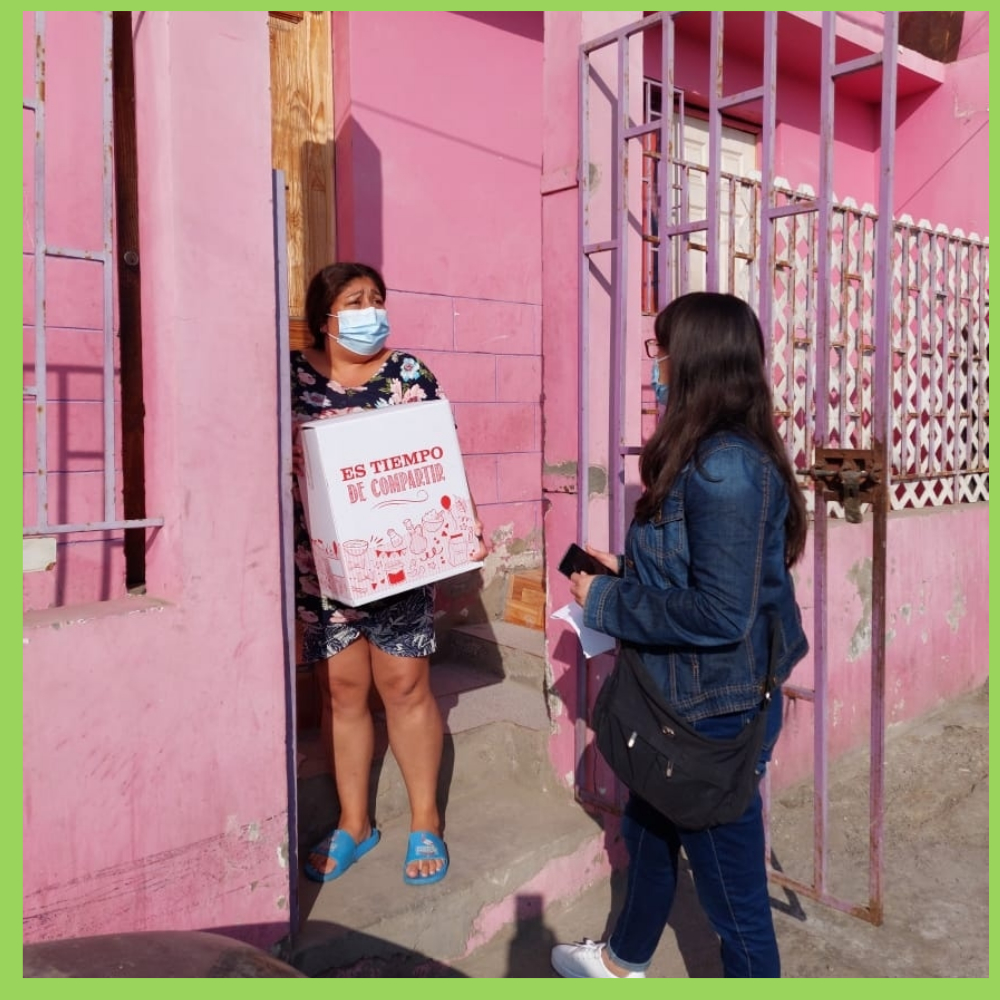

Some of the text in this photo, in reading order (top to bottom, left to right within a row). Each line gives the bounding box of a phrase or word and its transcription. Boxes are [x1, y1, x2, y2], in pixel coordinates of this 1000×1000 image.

[340, 446, 444, 482] ES TIEMPO
[347, 463, 446, 504] DE COMPARTIR
